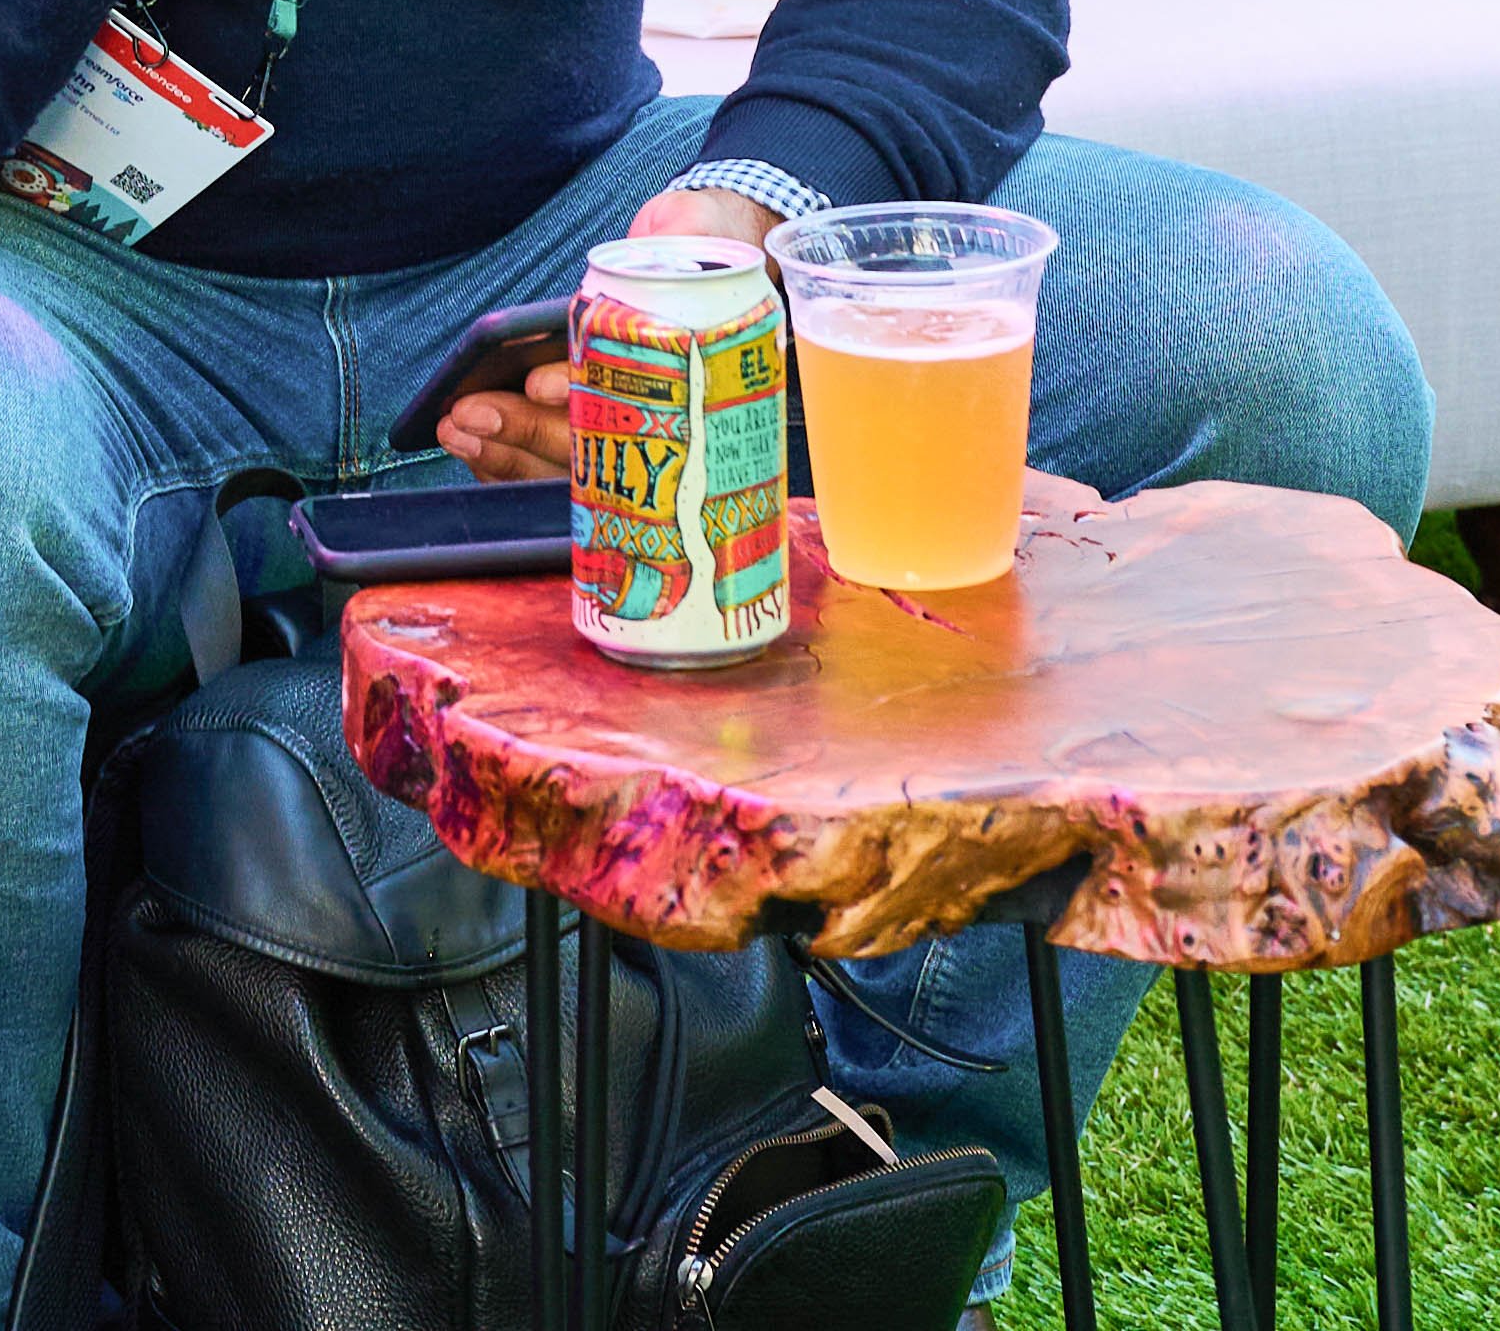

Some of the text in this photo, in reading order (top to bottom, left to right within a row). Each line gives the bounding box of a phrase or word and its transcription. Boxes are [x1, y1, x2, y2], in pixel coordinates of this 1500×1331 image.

[82, 54, 145, 104] reamforce
[79, 102, 105, 128] Times
[740, 345, 772, 381] EL
[582, 401, 622, 428] EZA
[710, 416, 743, 441] YOU
[743, 405, 769, 434] ARE
[714, 439, 741, 464] NOW
[572, 433, 681, 510] ULLY
[715, 463, 750, 491] HAVE
